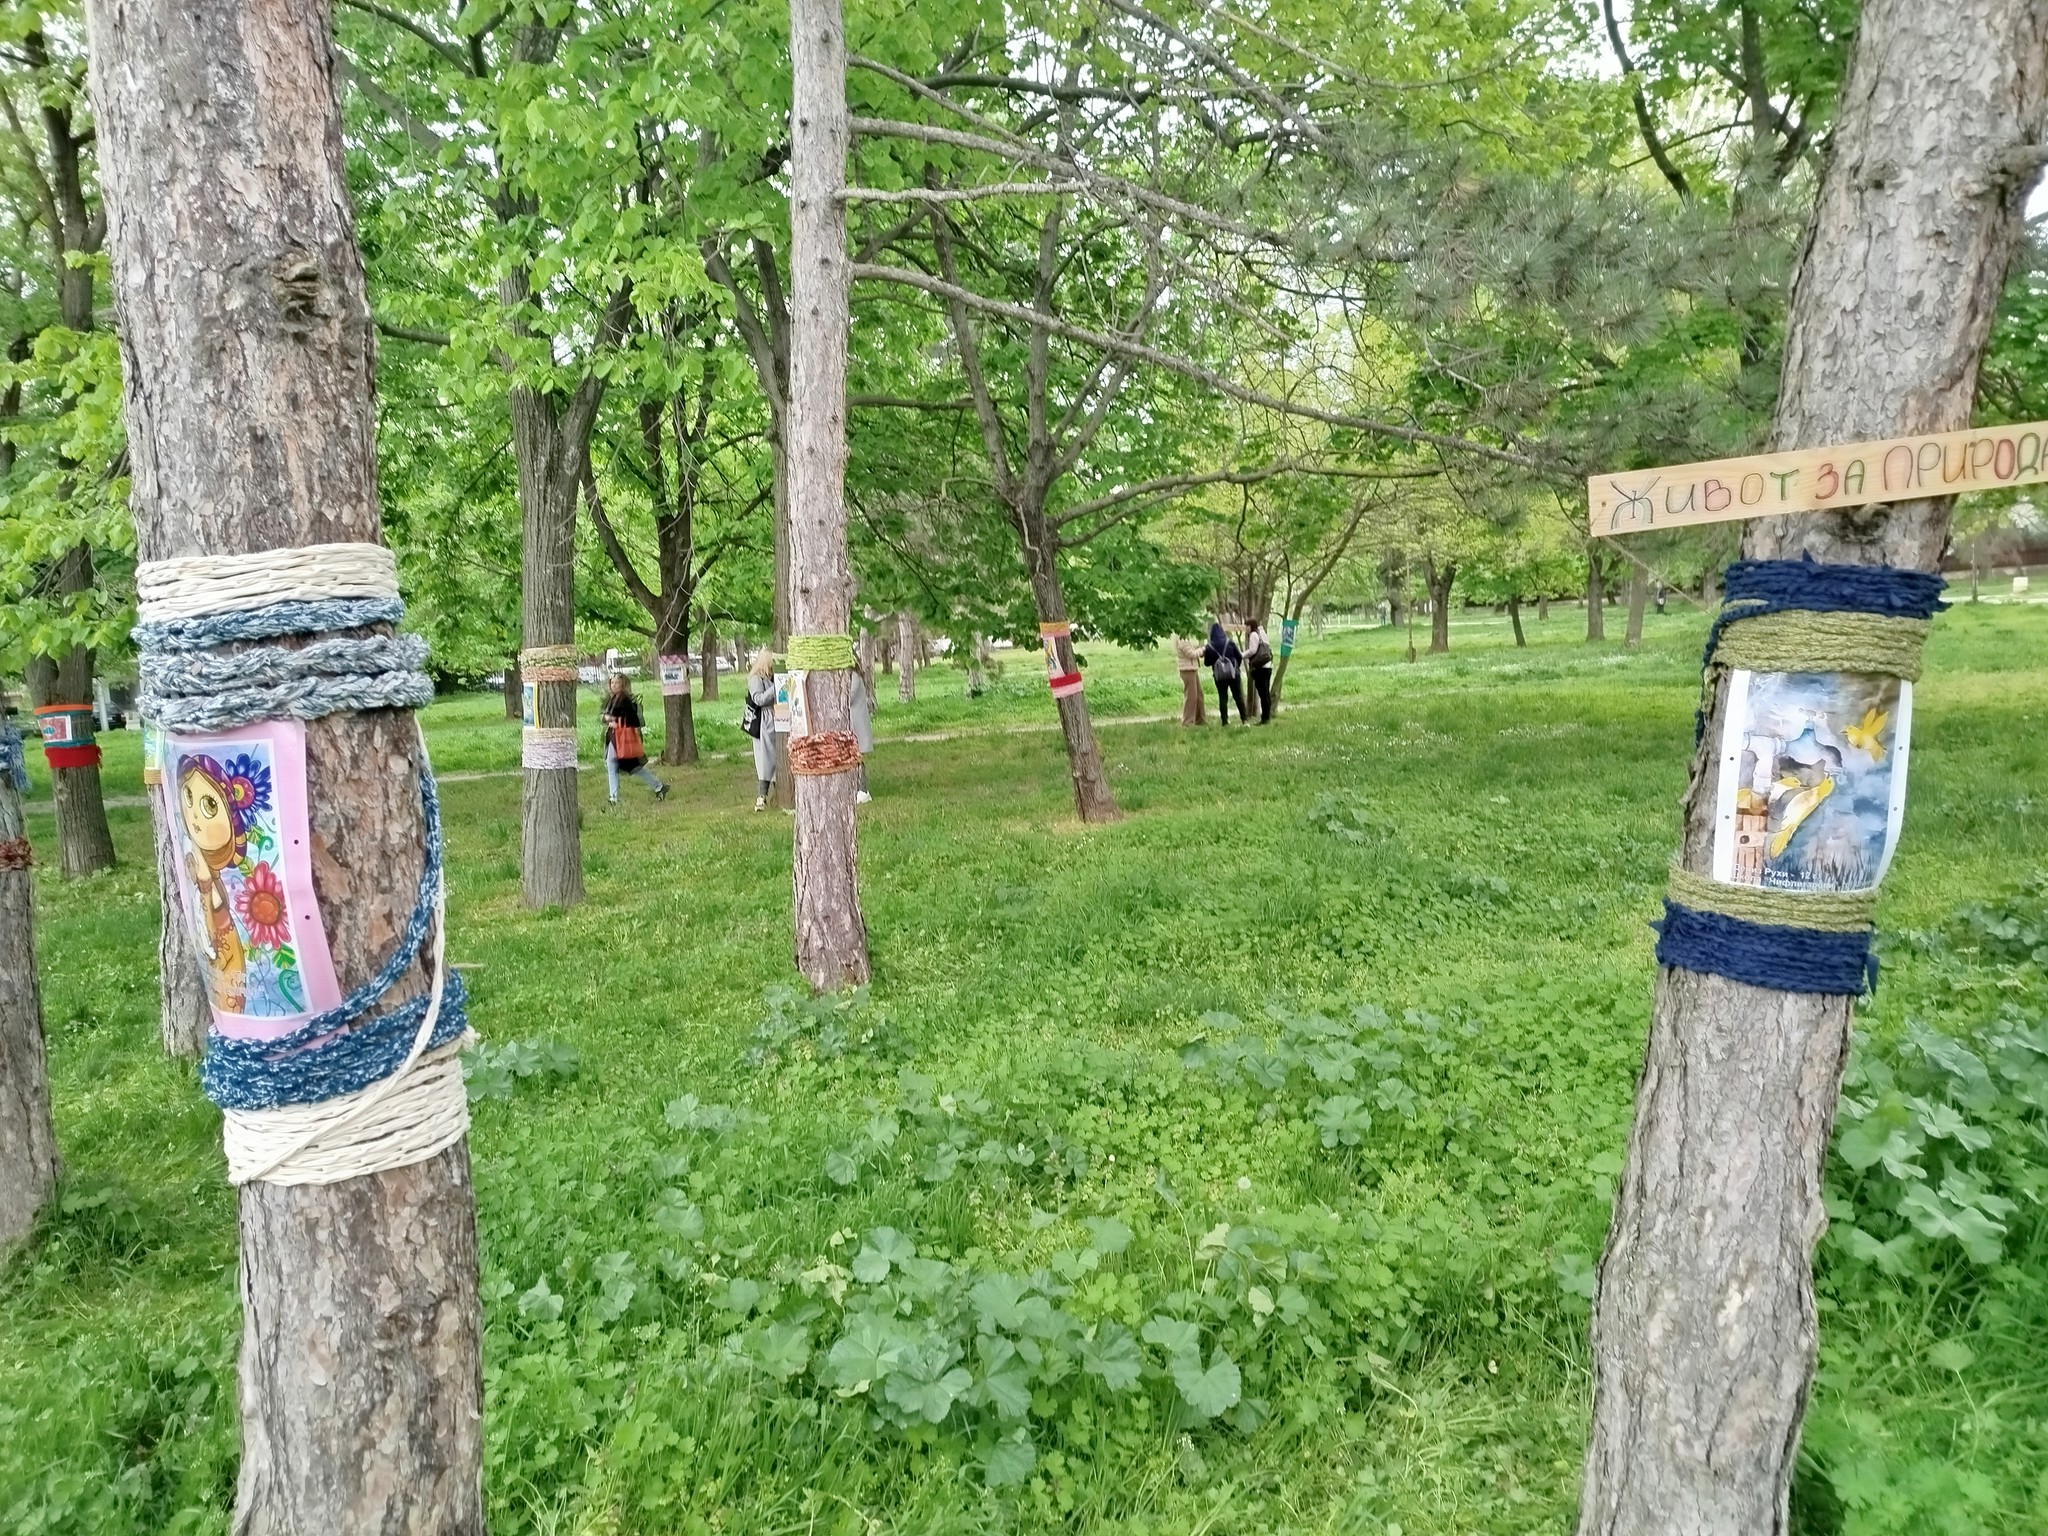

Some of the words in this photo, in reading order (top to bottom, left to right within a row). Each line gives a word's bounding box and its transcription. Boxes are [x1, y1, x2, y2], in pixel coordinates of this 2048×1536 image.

[1608, 466, 1800, 532] ЖИВОТ
[1814, 458, 1867, 501] ЗА
[1764, 867, 1789, 878] Рухи
[1800, 871, 1811, 880] 12
